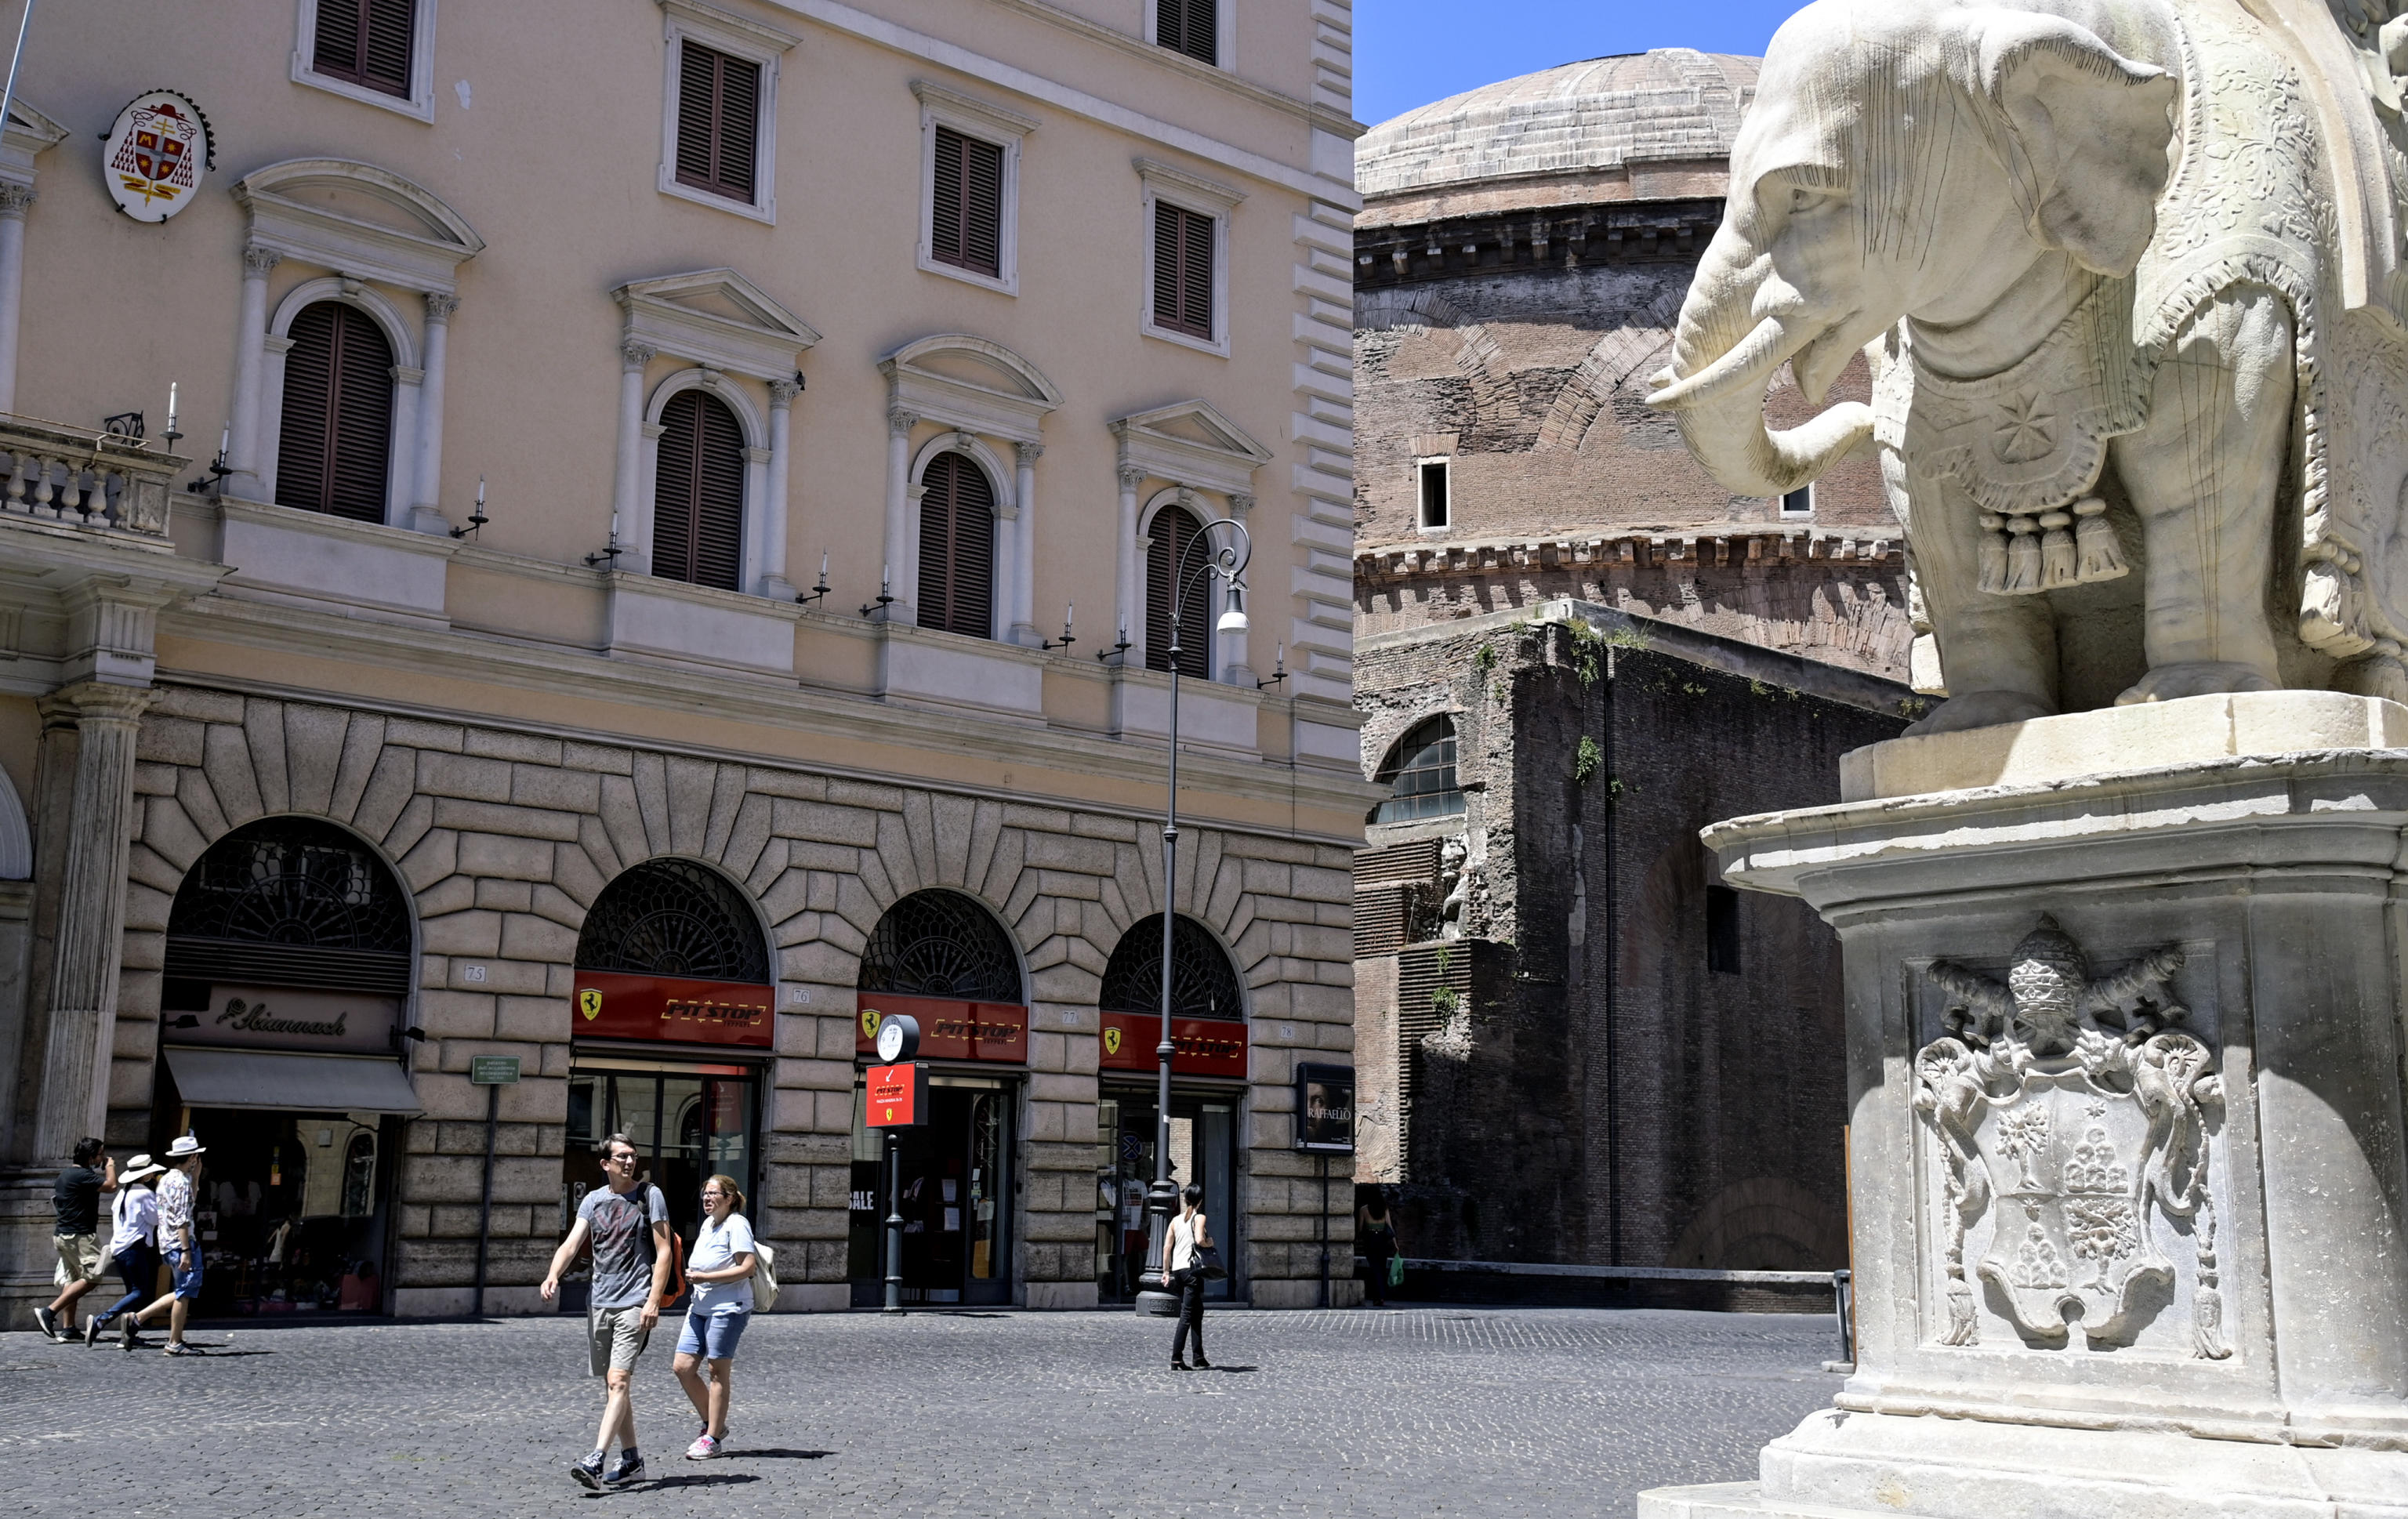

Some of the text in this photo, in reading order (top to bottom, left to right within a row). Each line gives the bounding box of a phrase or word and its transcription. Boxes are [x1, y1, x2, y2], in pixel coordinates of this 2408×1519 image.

[468, 966, 482, 980] 75
[795, 990, 808, 1002] 76
[667, 1003, 761, 1020] PIT STOP
[1064, 1012, 1075, 1022] 77
[937, 1023, 1016, 1038] PIT STOP
[1282, 1027, 1292, 1036] 78
[1198, 1042, 1238, 1053] STOP
[1308, 1108, 1351, 1120] RAFFAELLO
